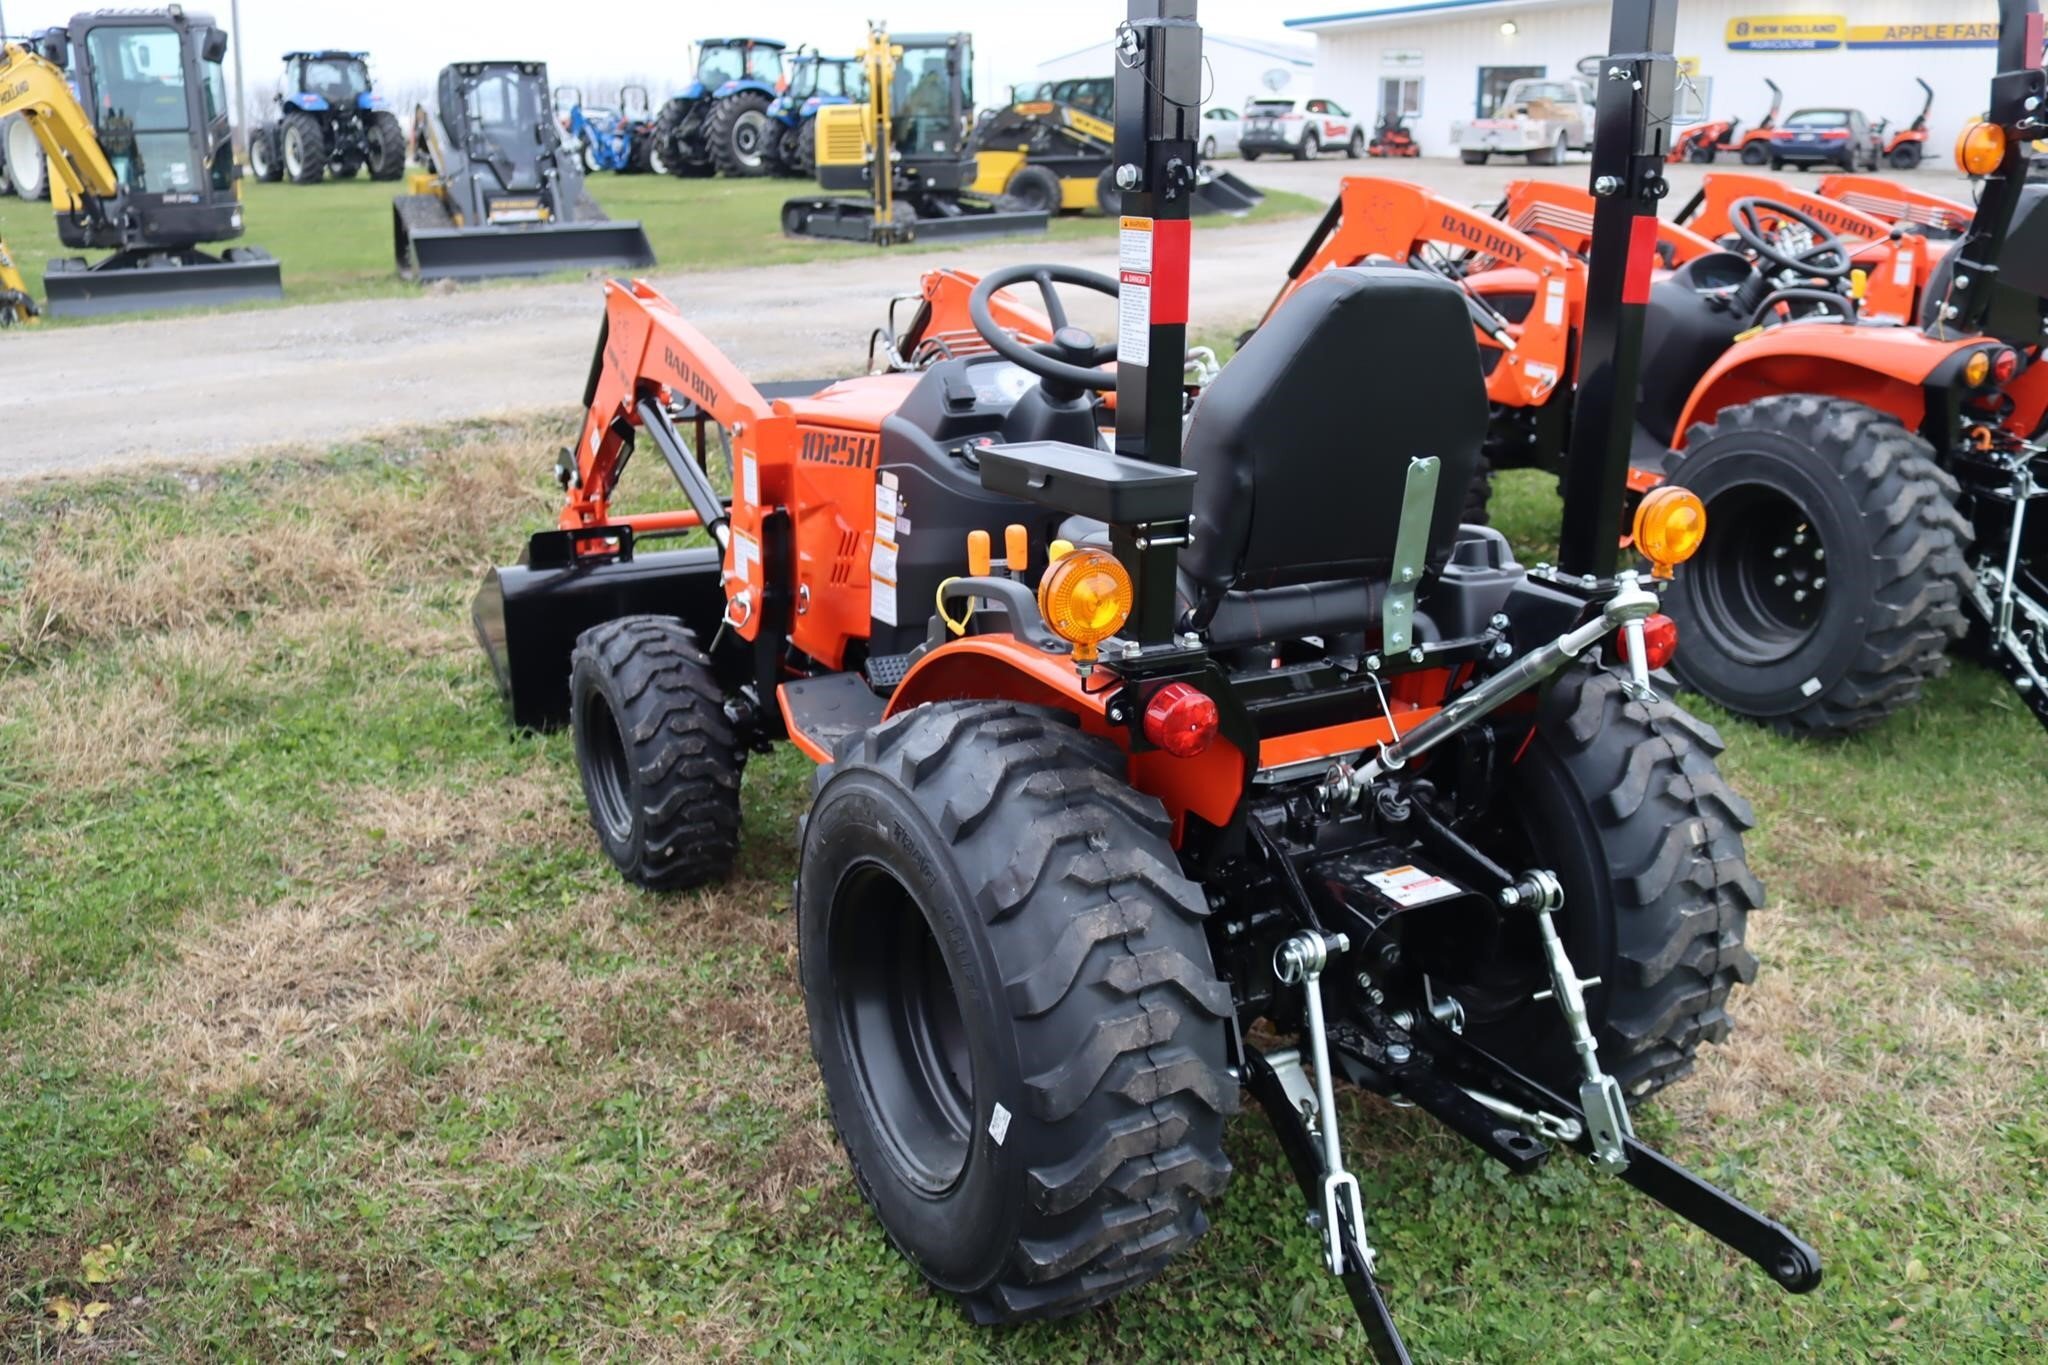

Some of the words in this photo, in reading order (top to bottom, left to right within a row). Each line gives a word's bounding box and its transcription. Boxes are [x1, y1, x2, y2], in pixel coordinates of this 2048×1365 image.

[1752, 25, 1778, 33] NEW
[1782, 24, 1836, 33] HOLLAND
[1884, 26, 1947, 40] APPLE
[1441, 215, 1482, 243] BAD
[1485, 234, 1526, 262] BOY
[1800, 203, 1838, 225] BAD
[1841, 217, 1878, 239] BOY
[665, 346, 689, 383] BAD
[691, 371, 719, 409] BOY
[802, 431, 876, 469] 1025H
